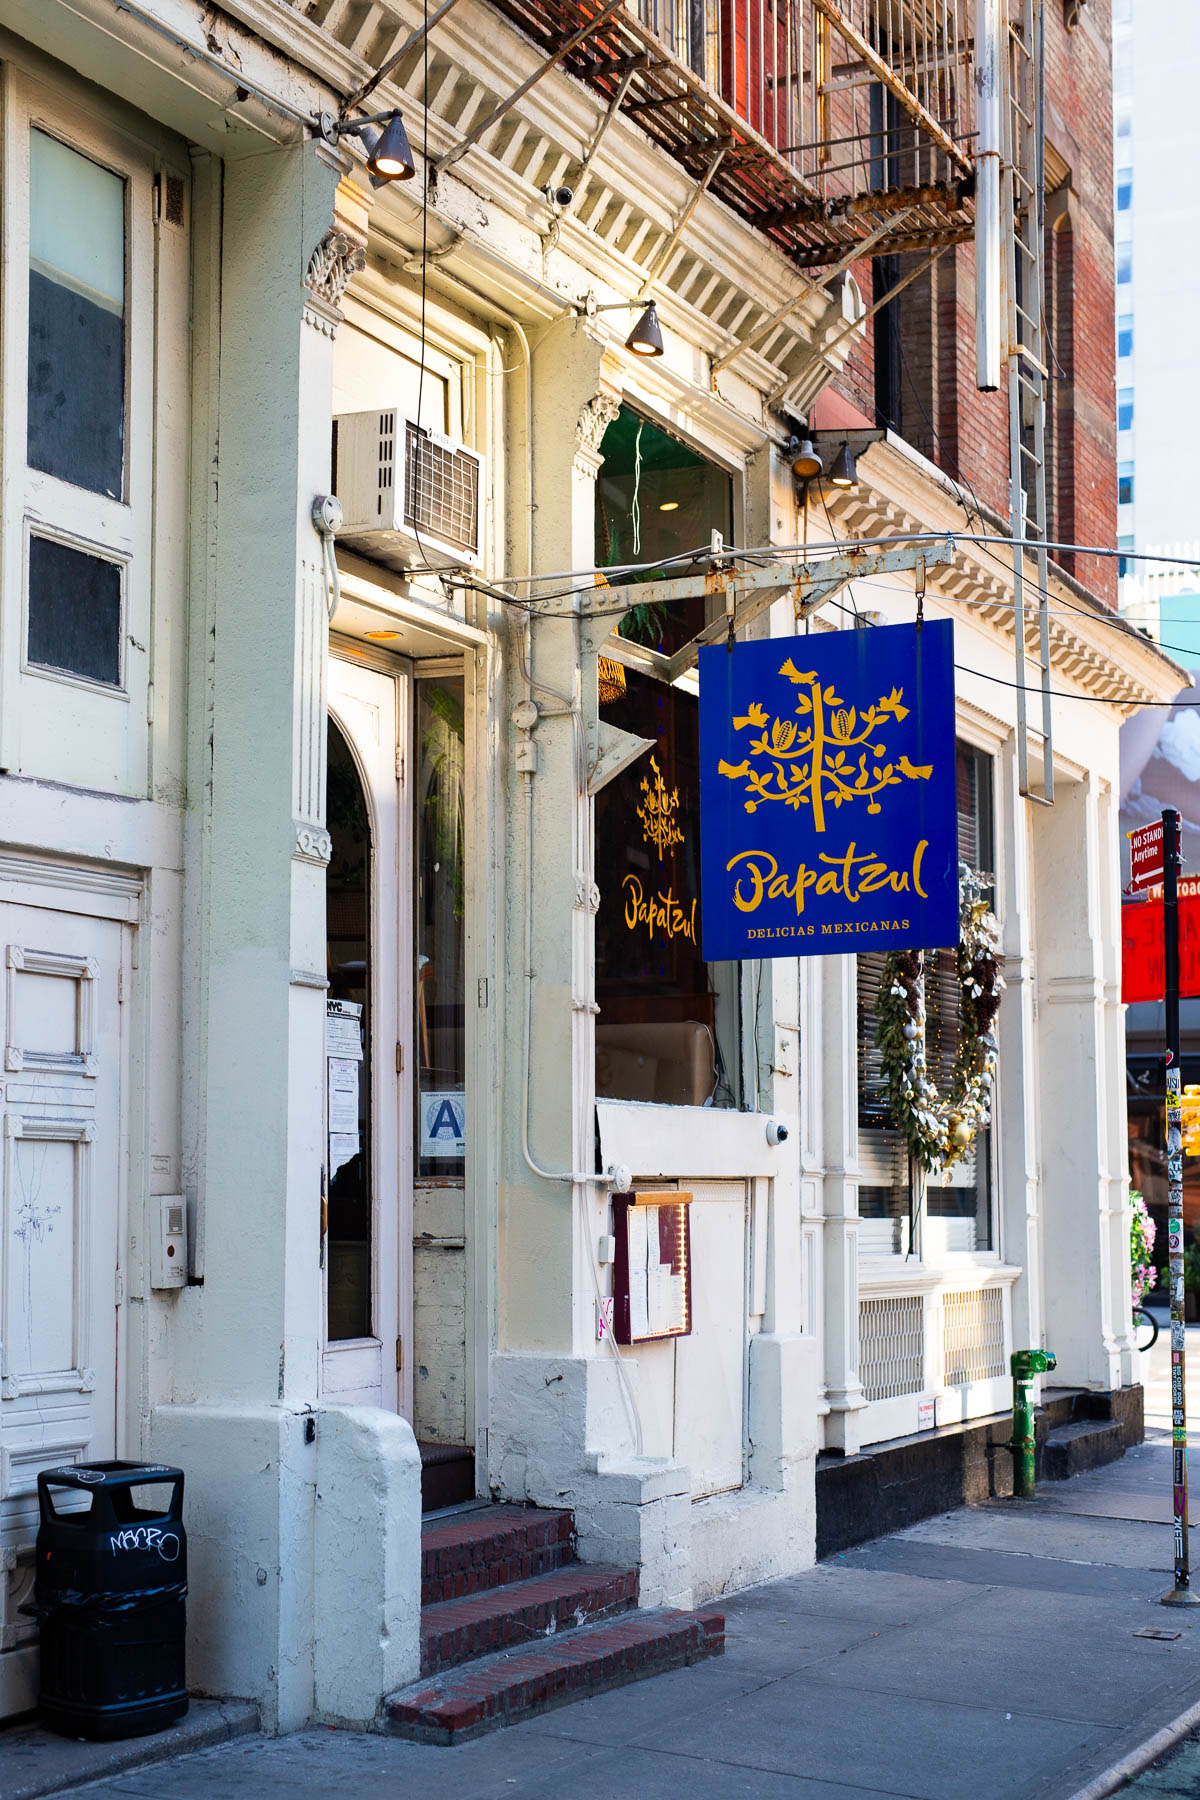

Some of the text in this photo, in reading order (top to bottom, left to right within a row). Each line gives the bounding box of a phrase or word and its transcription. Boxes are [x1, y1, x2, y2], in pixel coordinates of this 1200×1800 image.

[1133, 826, 1164, 849] NO STANDI
[1134, 846, 1158, 863] Anytime
[726, 839, 929, 916] Papatzul
[622, 873, 697, 946] Papatzul
[747, 919, 910, 939] DELICIAS MEXICANAS
[429, 1099, 462, 1138] A
